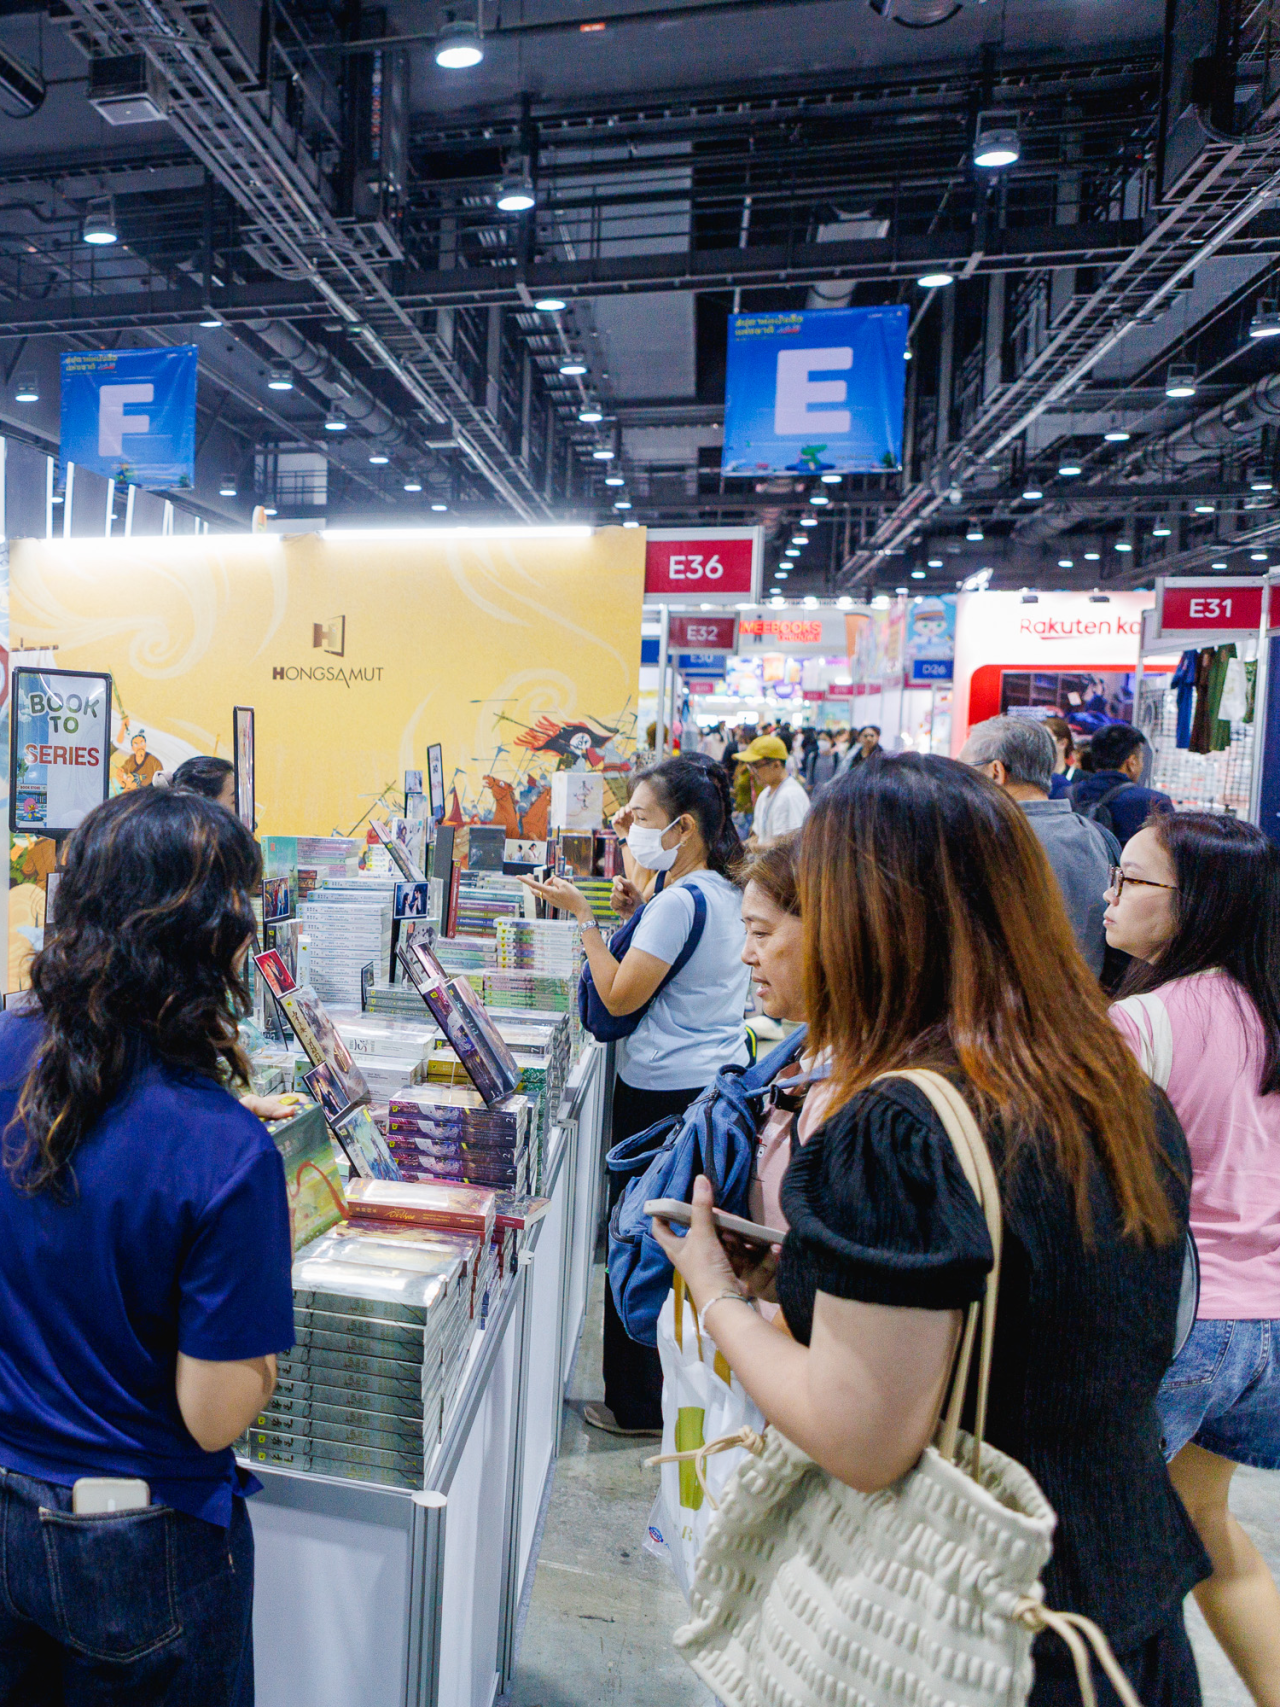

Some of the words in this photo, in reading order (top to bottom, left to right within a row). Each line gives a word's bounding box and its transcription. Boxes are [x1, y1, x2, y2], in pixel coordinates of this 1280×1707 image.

[774, 346, 854, 436] E
[98, 383, 154, 457] F
[669, 554, 724, 580] E36
[1189, 598, 1233, 618] E31
[686, 625, 718, 641] E32
[1020, 617, 1111, 635] Rakuten
[272, 666, 384, 689] HONGSAMUT
[29, 693, 100, 718] BOOK
[49, 715, 79, 733] TO
[24, 744, 100, 767] SERIES
